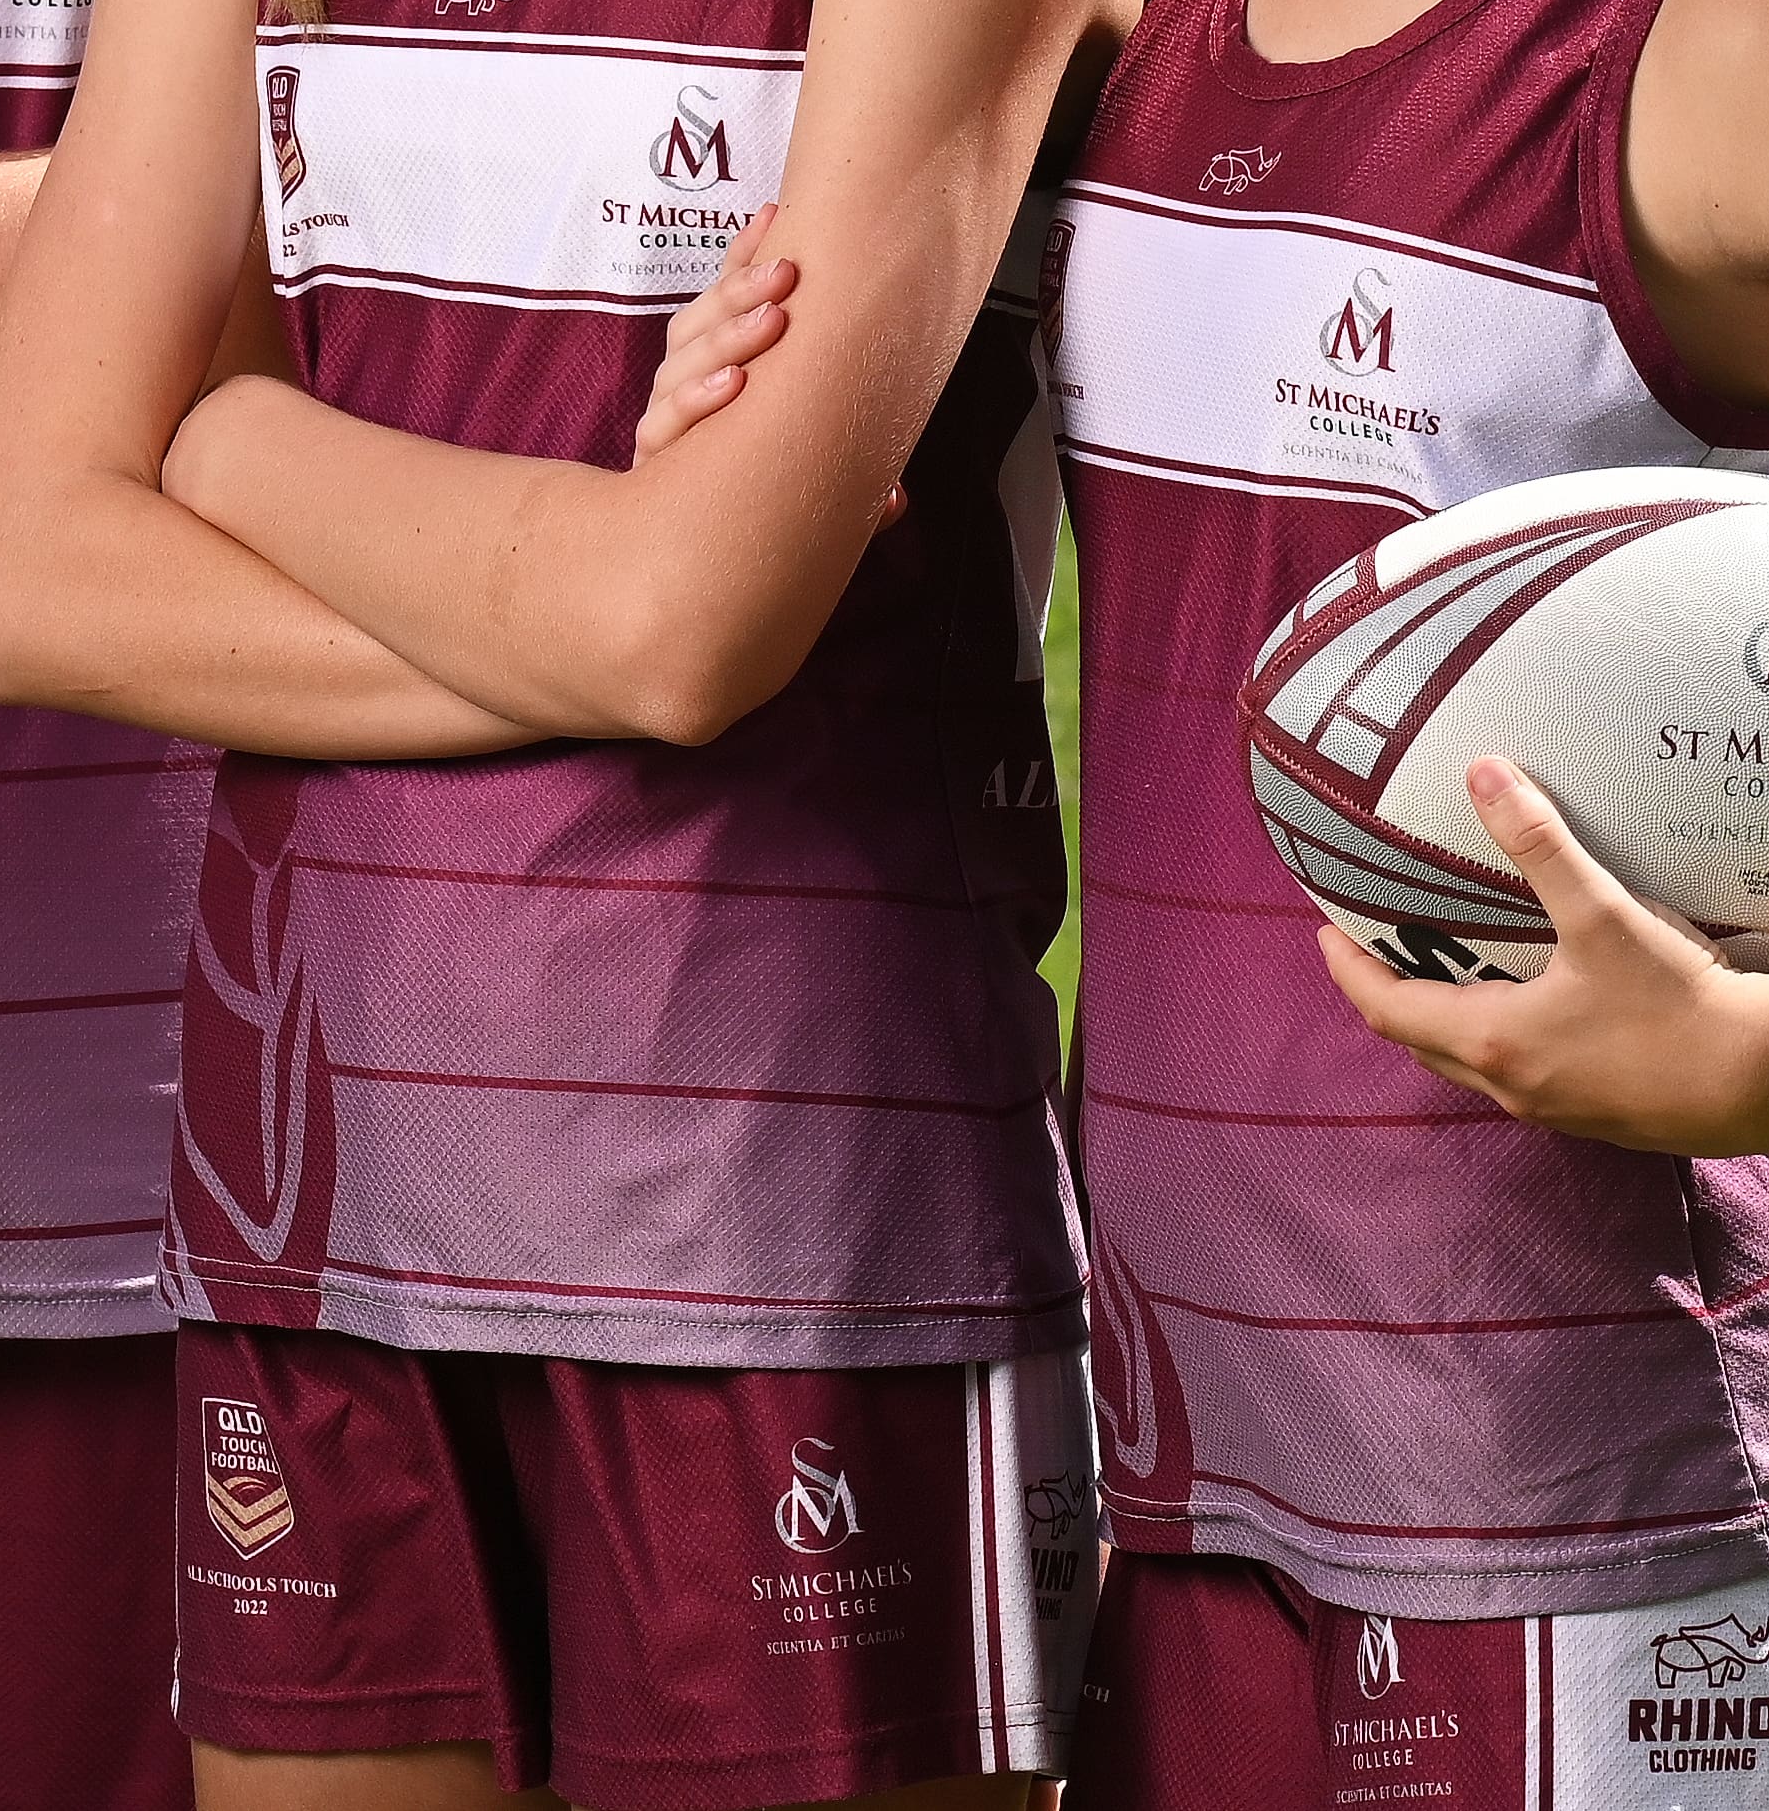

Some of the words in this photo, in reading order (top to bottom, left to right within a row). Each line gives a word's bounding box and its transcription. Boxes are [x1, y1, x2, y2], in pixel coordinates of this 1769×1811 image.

[300, 213, 350, 231] TOUCH
[602, 199, 631, 225] ST
[282, 243, 298, 258] 22
[639, 233, 728, 249] COLLEG
[1275, 378, 1302, 406] ST
[1307, 383, 1441, 436] MICHAEL'S
[1309, 415, 1394, 448] COLLEGE
[1656, 724, 1709, 761] ST
[982, 757, 1059, 809] AL
[217, 1406, 263, 1436] QLD
[219, 1435, 268, 1456] TOUCH
[211, 1452, 279, 1475] FOOTBALL
[207, 1569, 277, 1592] SCHOOLS
[279, 1577, 338, 1598] TOUCH
[751, 1575, 773, 1601] ST
[779, 1557, 912, 1599] MICHAEL'S
[233, 1598, 269, 1616] 2022
[783, 1597, 877, 1623] COLLEGE
[766, 1638, 824, 1656] SCIENTIA
[830, 1634, 851, 1650] ET
[856, 1627, 906, 1646] CARITAS
[1333, 1719, 1350, 1747] ST
[1352, 1709, 1460, 1746] MICHAEL'S
[1352, 1748, 1414, 1771] COLLEGE
[1648, 1747, 1758, 1774] CLOTHING
[1392, 1780, 1453, 1800] CARITAS
